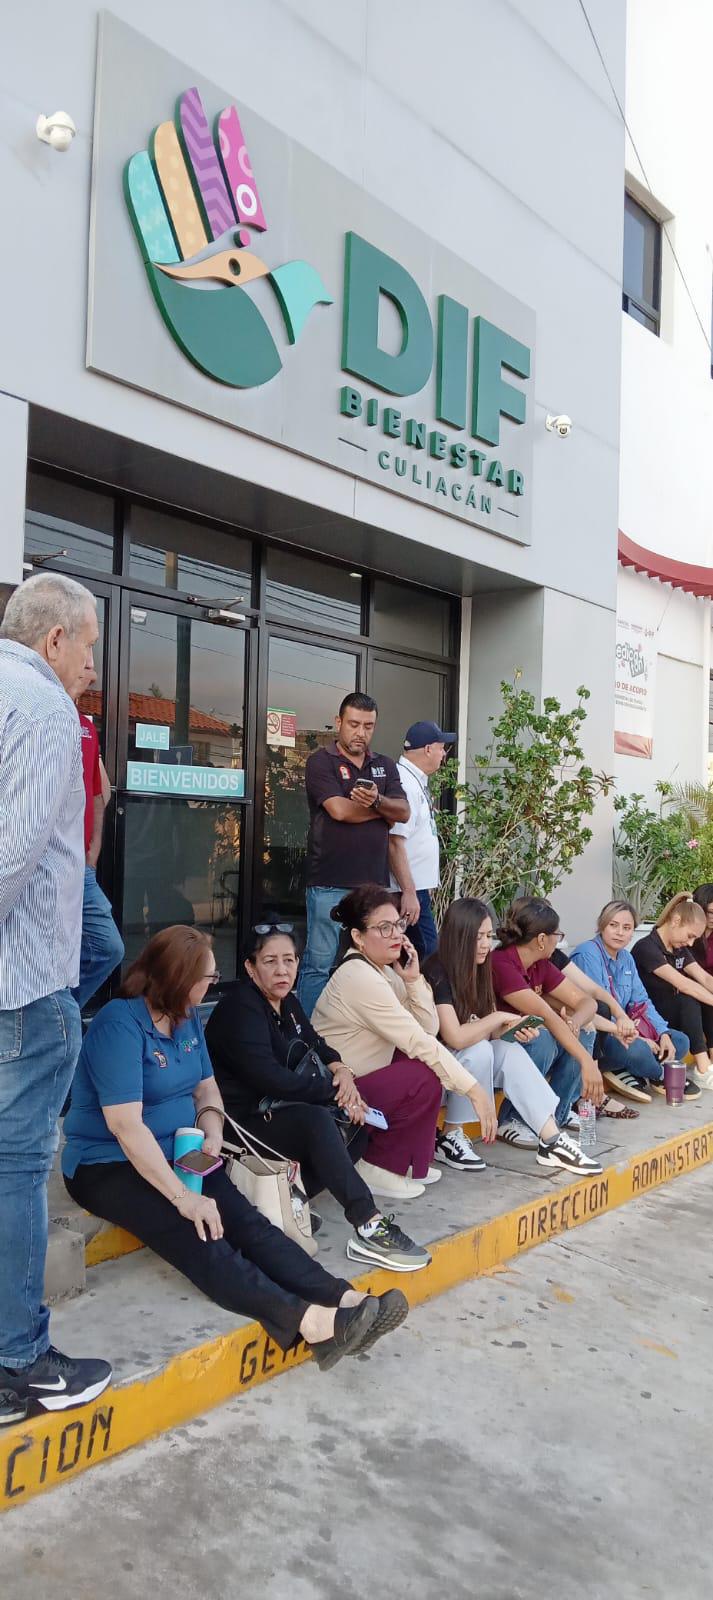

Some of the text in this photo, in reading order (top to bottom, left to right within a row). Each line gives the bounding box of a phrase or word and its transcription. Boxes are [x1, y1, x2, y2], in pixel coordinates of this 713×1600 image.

[341, 230, 531, 448] DIF
[338, 385, 525, 497] BIENESTAR
[377, 450, 492, 514] CULIACÁN
[621, 682, 629, 691] DE
[139, 731, 167, 744] JALE
[130, 767, 239, 791] BIENVENIDOS
[516, 1179, 609, 1247] DIRECCION
[4, 1406, 114, 1498] CION
